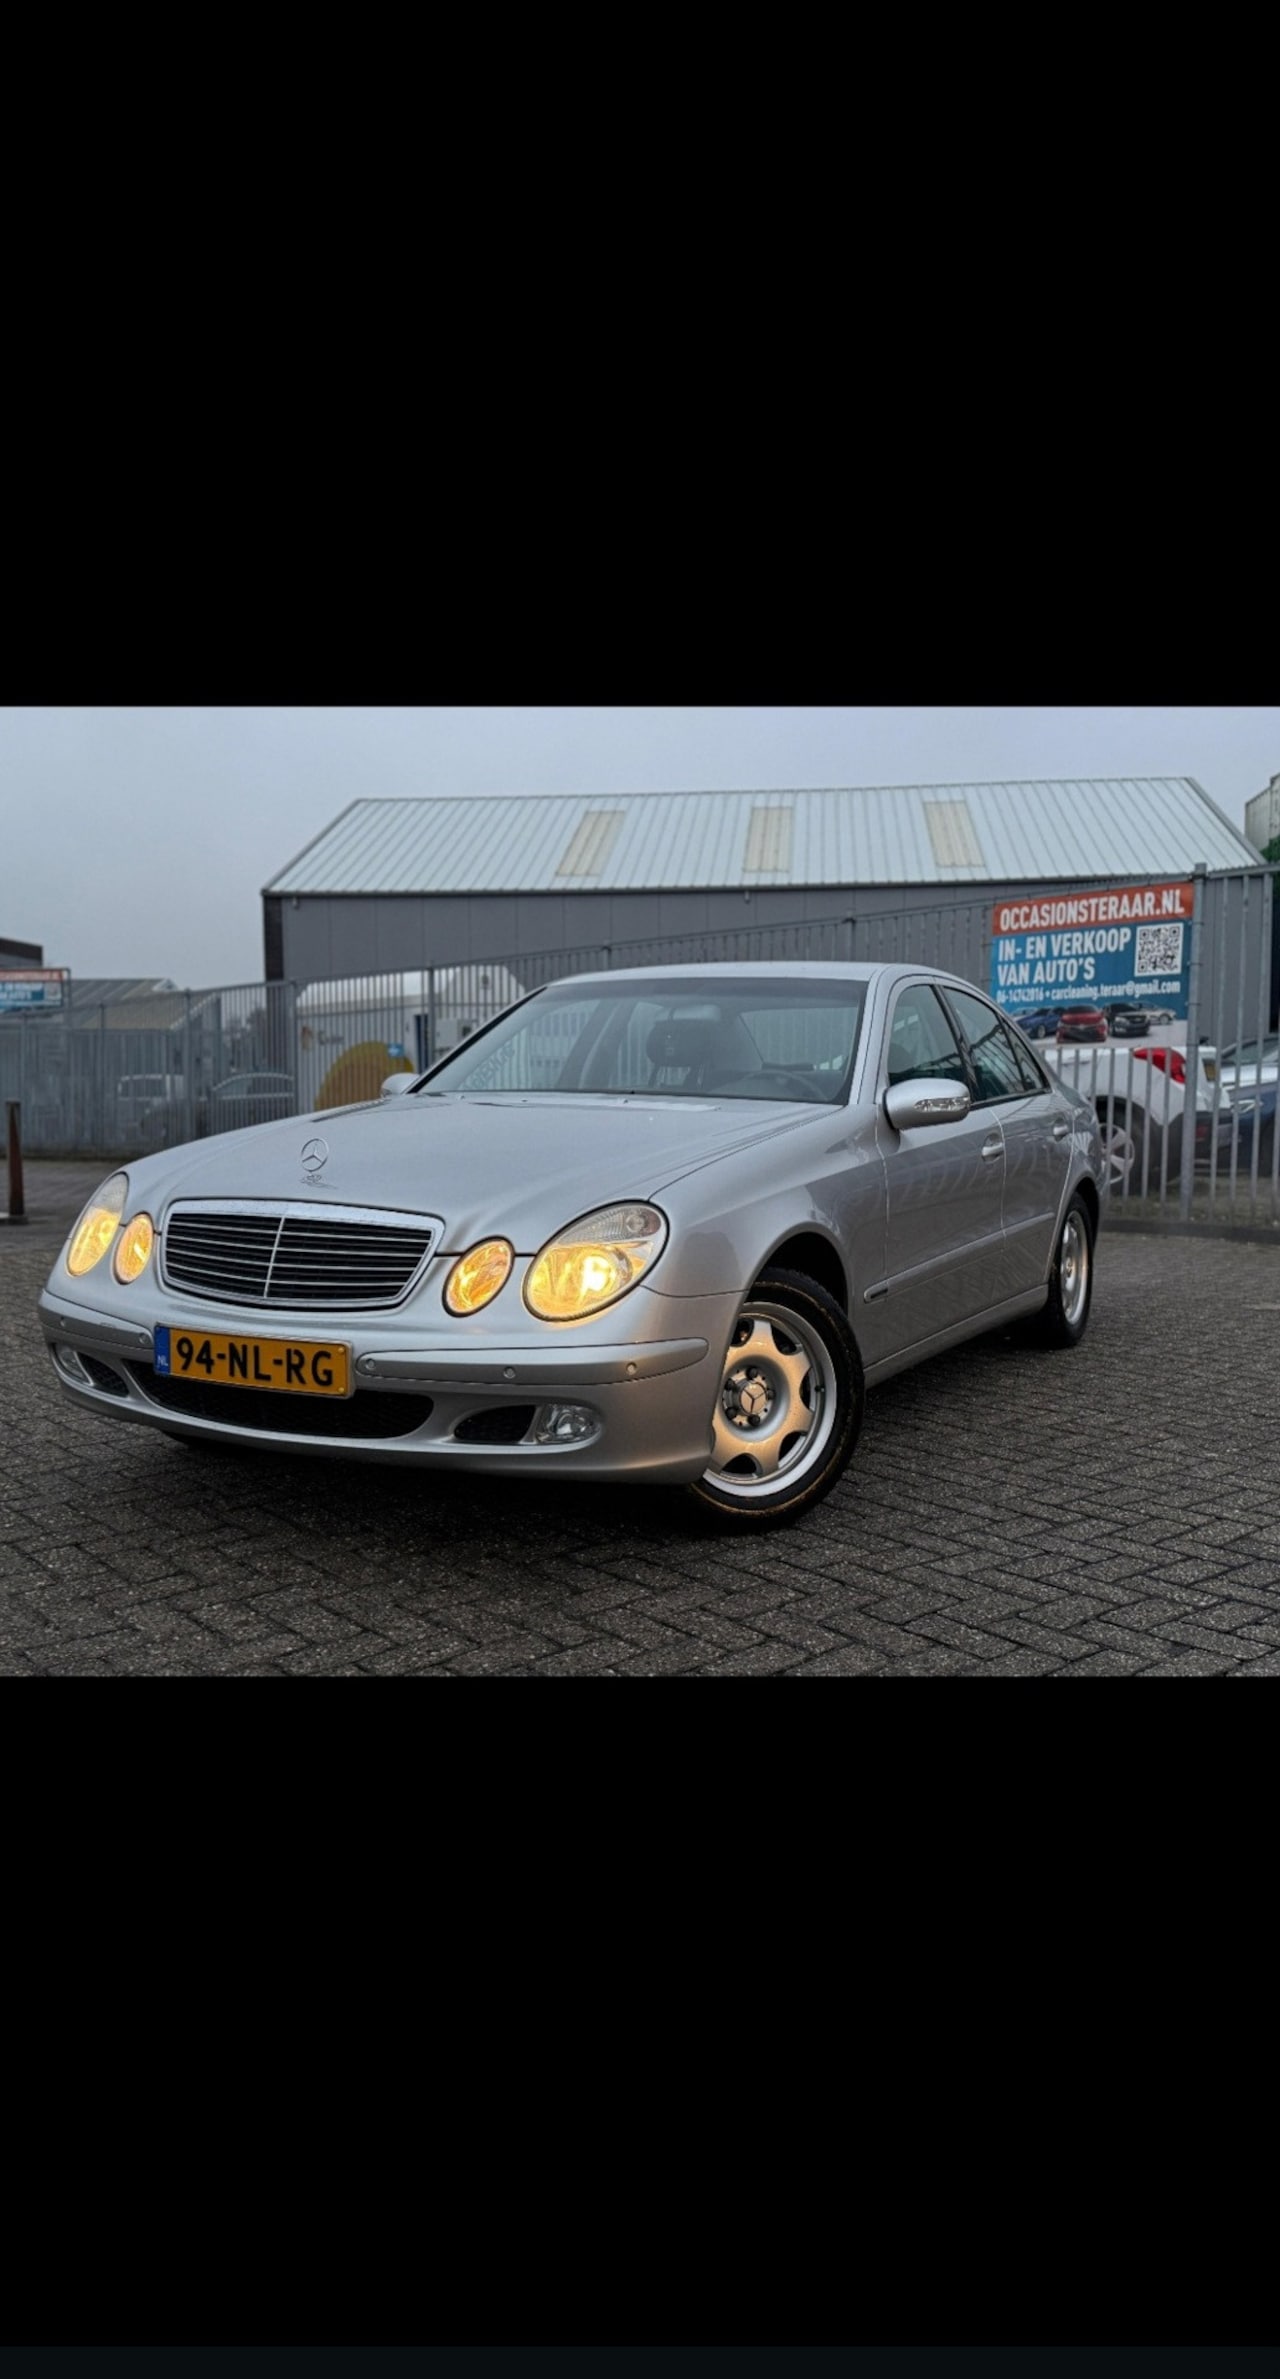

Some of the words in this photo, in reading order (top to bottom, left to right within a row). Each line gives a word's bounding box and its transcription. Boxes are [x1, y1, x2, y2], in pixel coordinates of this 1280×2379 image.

[1000, 889, 1185, 931] OCCASIONSTERAAR.NL
[999, 939, 1022, 961] IN-
[1025, 936, 1046, 958] EN
[1051, 927, 1132, 957] VERKOOP
[997, 963, 1030, 986] VAN
[1033, 957, 1095, 984] AUTO'S
[1051, 980, 1181, 1001] carcleaning.teraar@gmail.com
[157, 1355, 168, 1366] NL
[177, 1337, 333, 1386] 94-NL-RG
